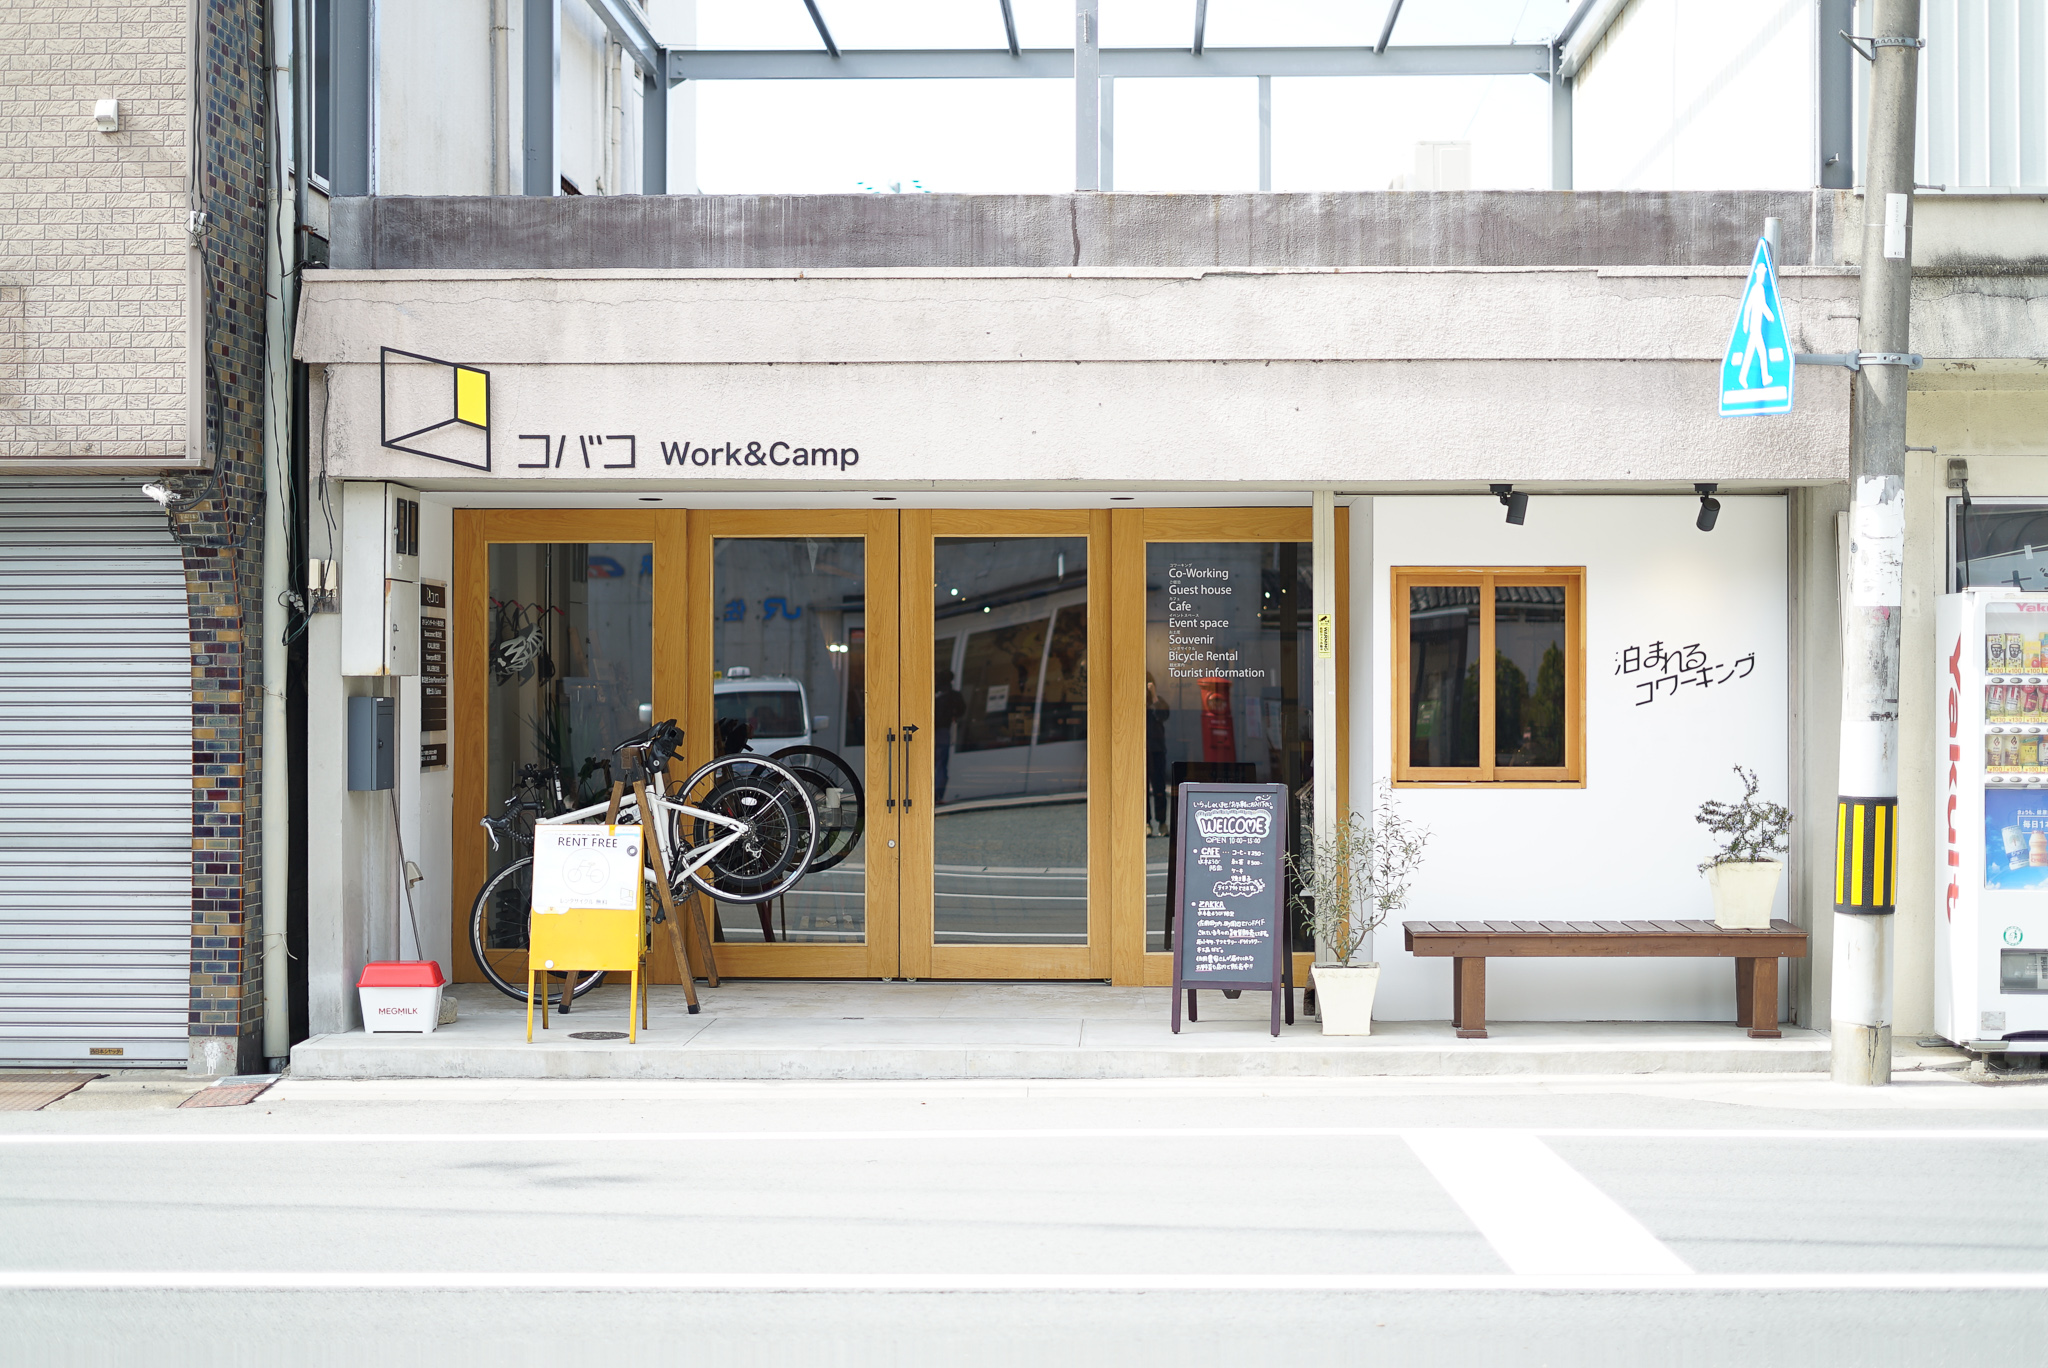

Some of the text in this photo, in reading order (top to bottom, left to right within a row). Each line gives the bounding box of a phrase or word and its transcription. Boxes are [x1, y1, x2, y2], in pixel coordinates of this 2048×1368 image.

[518, 434, 636, 469] コバコ
[660, 441, 860, 472] Work&Camp
[1168, 568, 1229, 580] Co-Working
[1168, 584, 1232, 595] Guest house
[1168, 601, 1192, 611] Cafe
[1169, 618, 1229, 630] Event space
[1168, 634, 1214, 645] Souvenir
[1168, 650, 1238, 663] Bicycle Rental
[1614, 640, 1707, 676] 泊まれる
[1168, 667, 1265, 678] Tourist information
[1635, 651, 1756, 707] コワーキング
[1201, 816, 1265, 834] WELCOME
[558, 837, 618, 849] RENT FREE
[1205, 836, 1227, 844] OPEN
[1200, 847, 1221, 855] CAFE
[378, 1007, 418, 1016] MEGMILK
